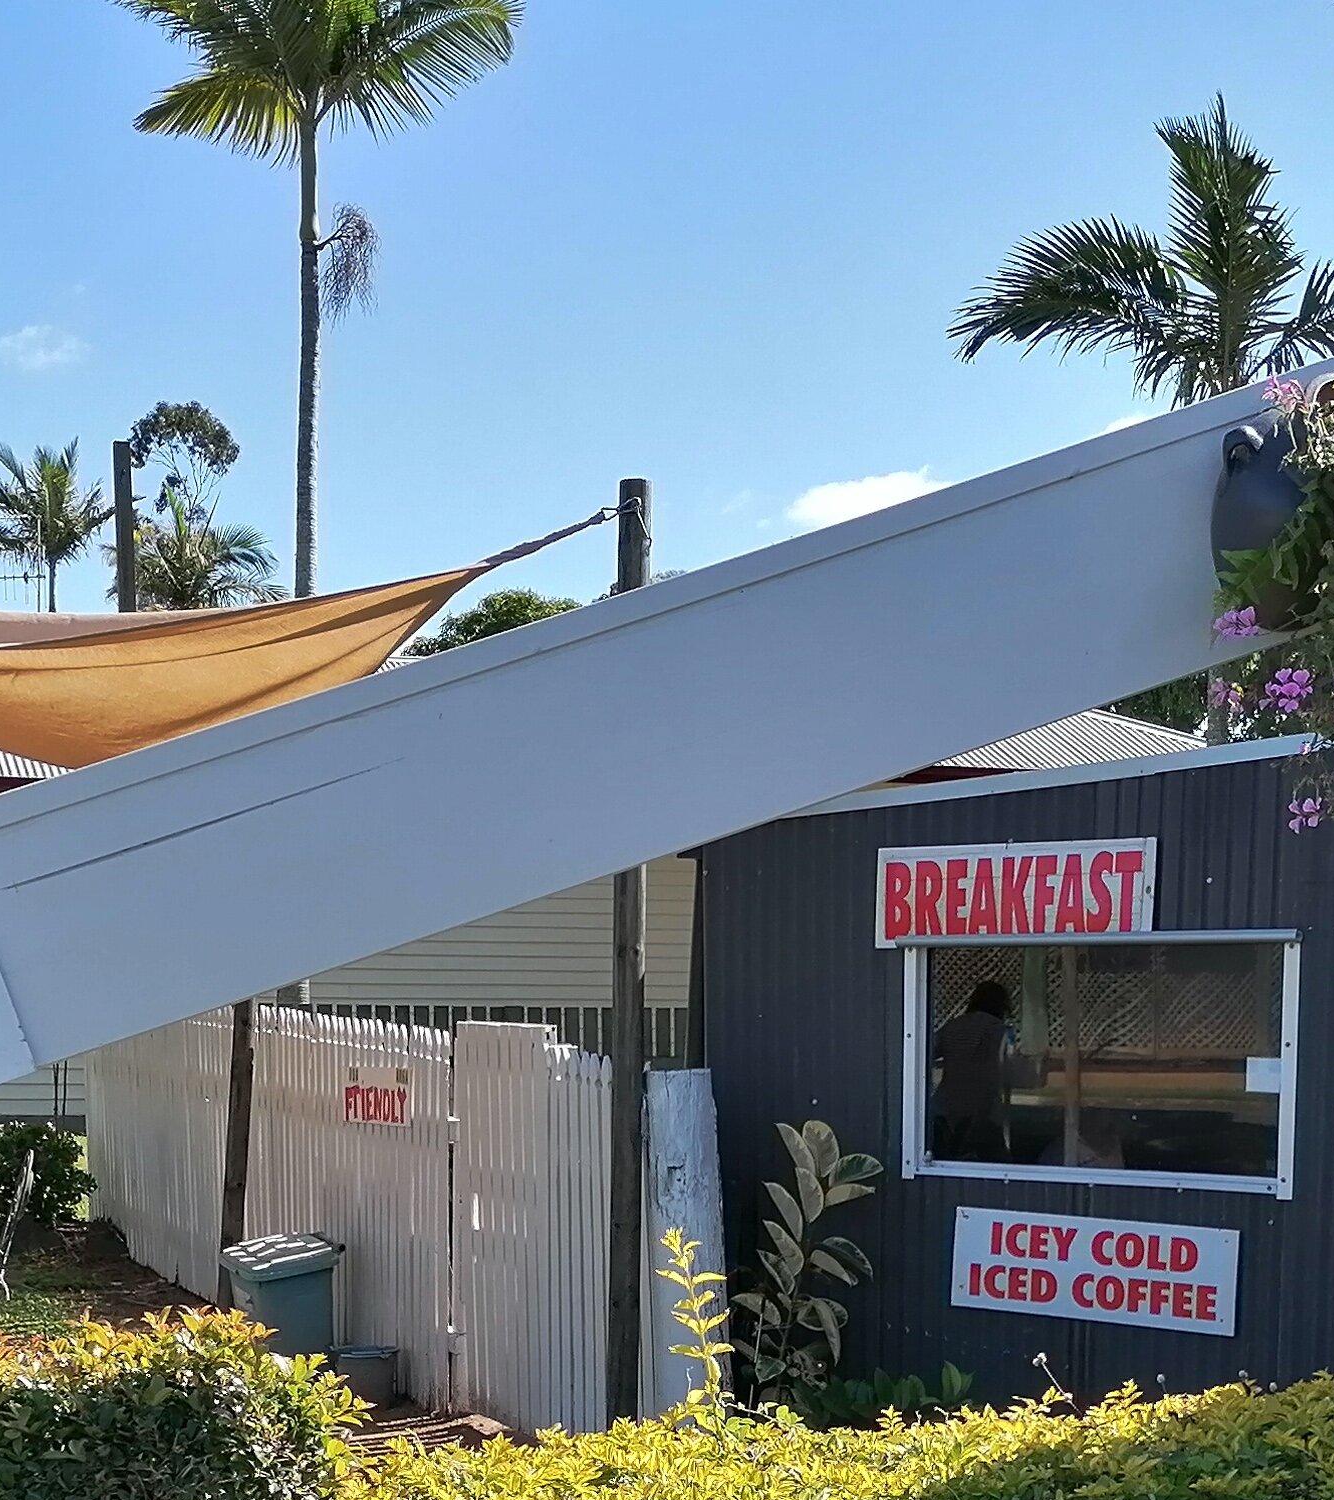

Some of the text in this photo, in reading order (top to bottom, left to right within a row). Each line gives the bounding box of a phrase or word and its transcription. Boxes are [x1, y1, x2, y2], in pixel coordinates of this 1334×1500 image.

[885, 851, 1143, 940] BREAKFAST
[990, 1221, 1199, 1273] ICEY COLD
[969, 1263, 1217, 1321] ICED COFFEE
